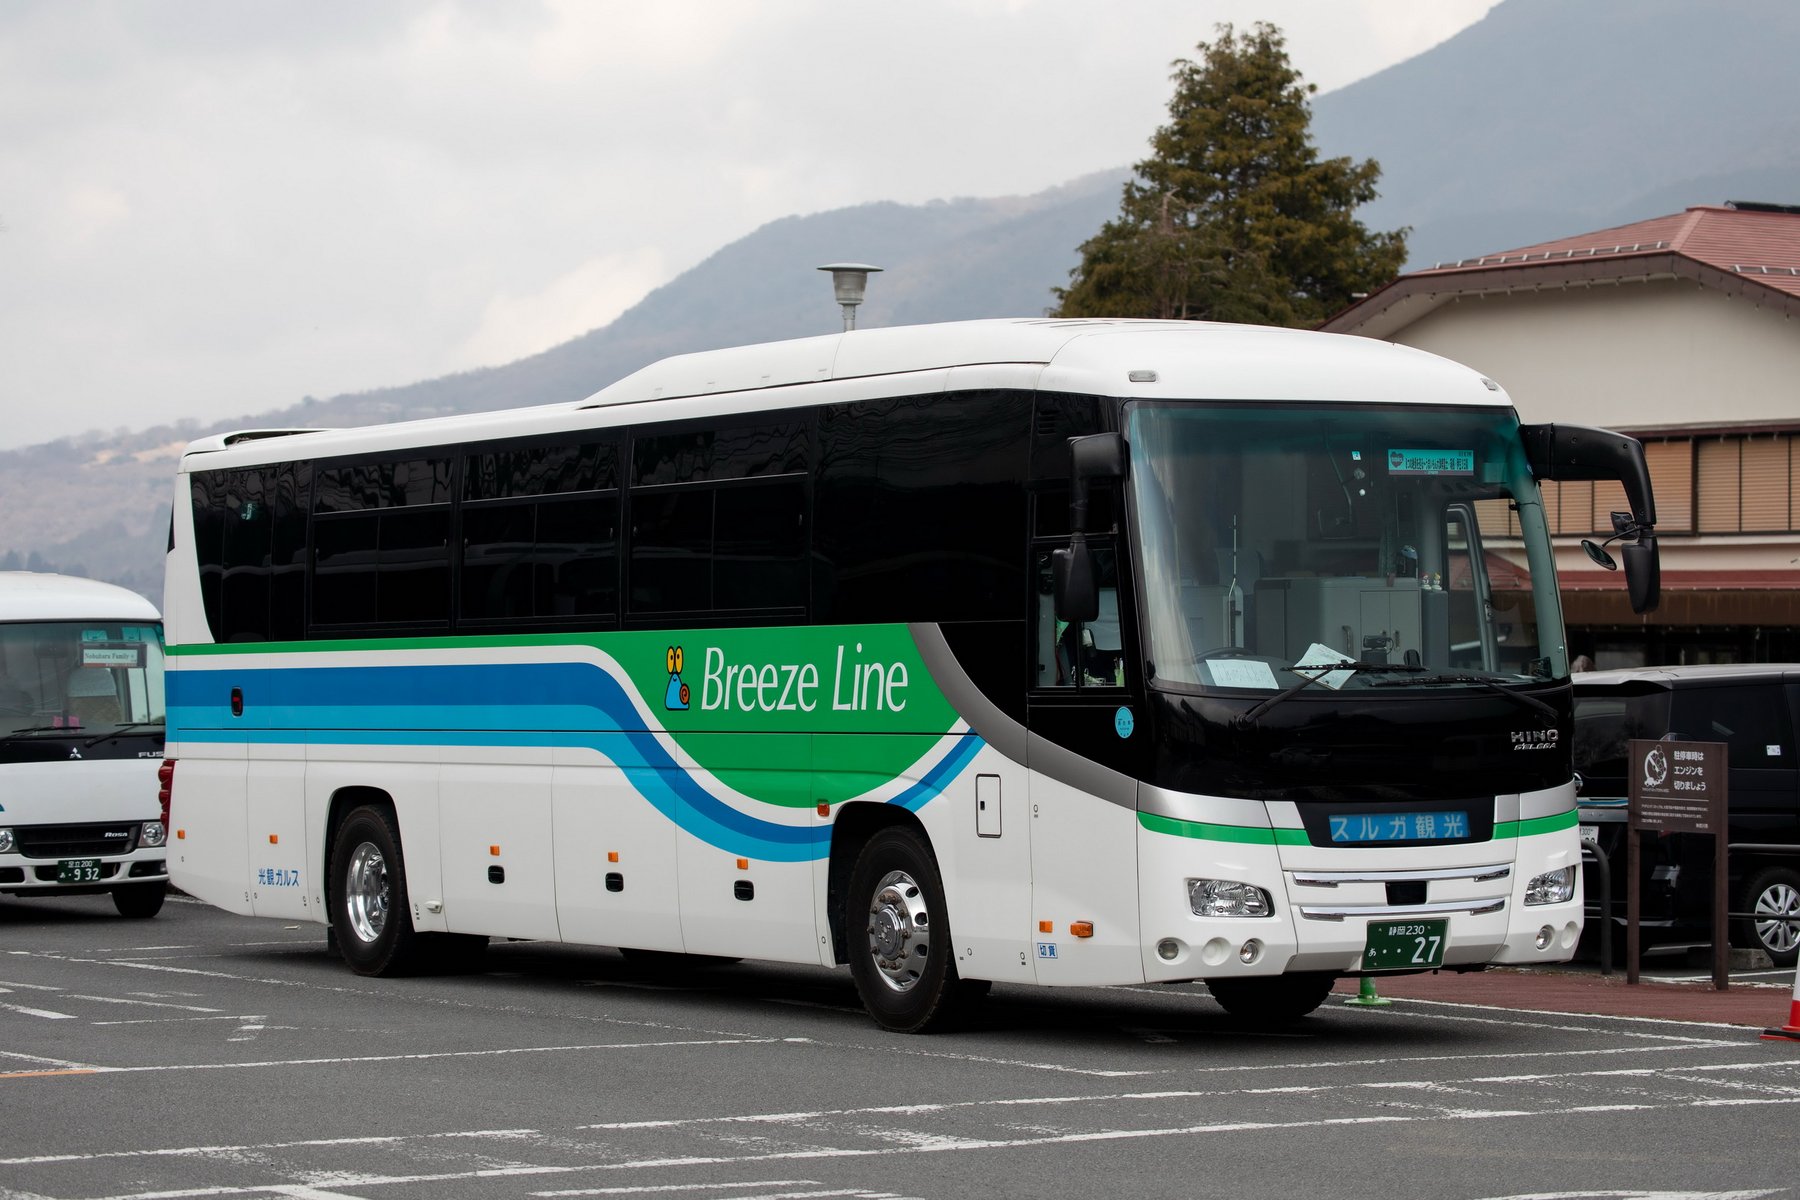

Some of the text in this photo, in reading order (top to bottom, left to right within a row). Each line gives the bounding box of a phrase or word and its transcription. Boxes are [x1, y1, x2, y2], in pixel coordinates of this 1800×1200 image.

[701, 642, 909, 712] Breeze Line
[1511, 729, 1559, 742] HINO
[1674, 766, 1703, 776] エンジンを
[1674, 780, 1706, 791] 切りましょう
[1329, 813, 1463, 841] スルガ観光
